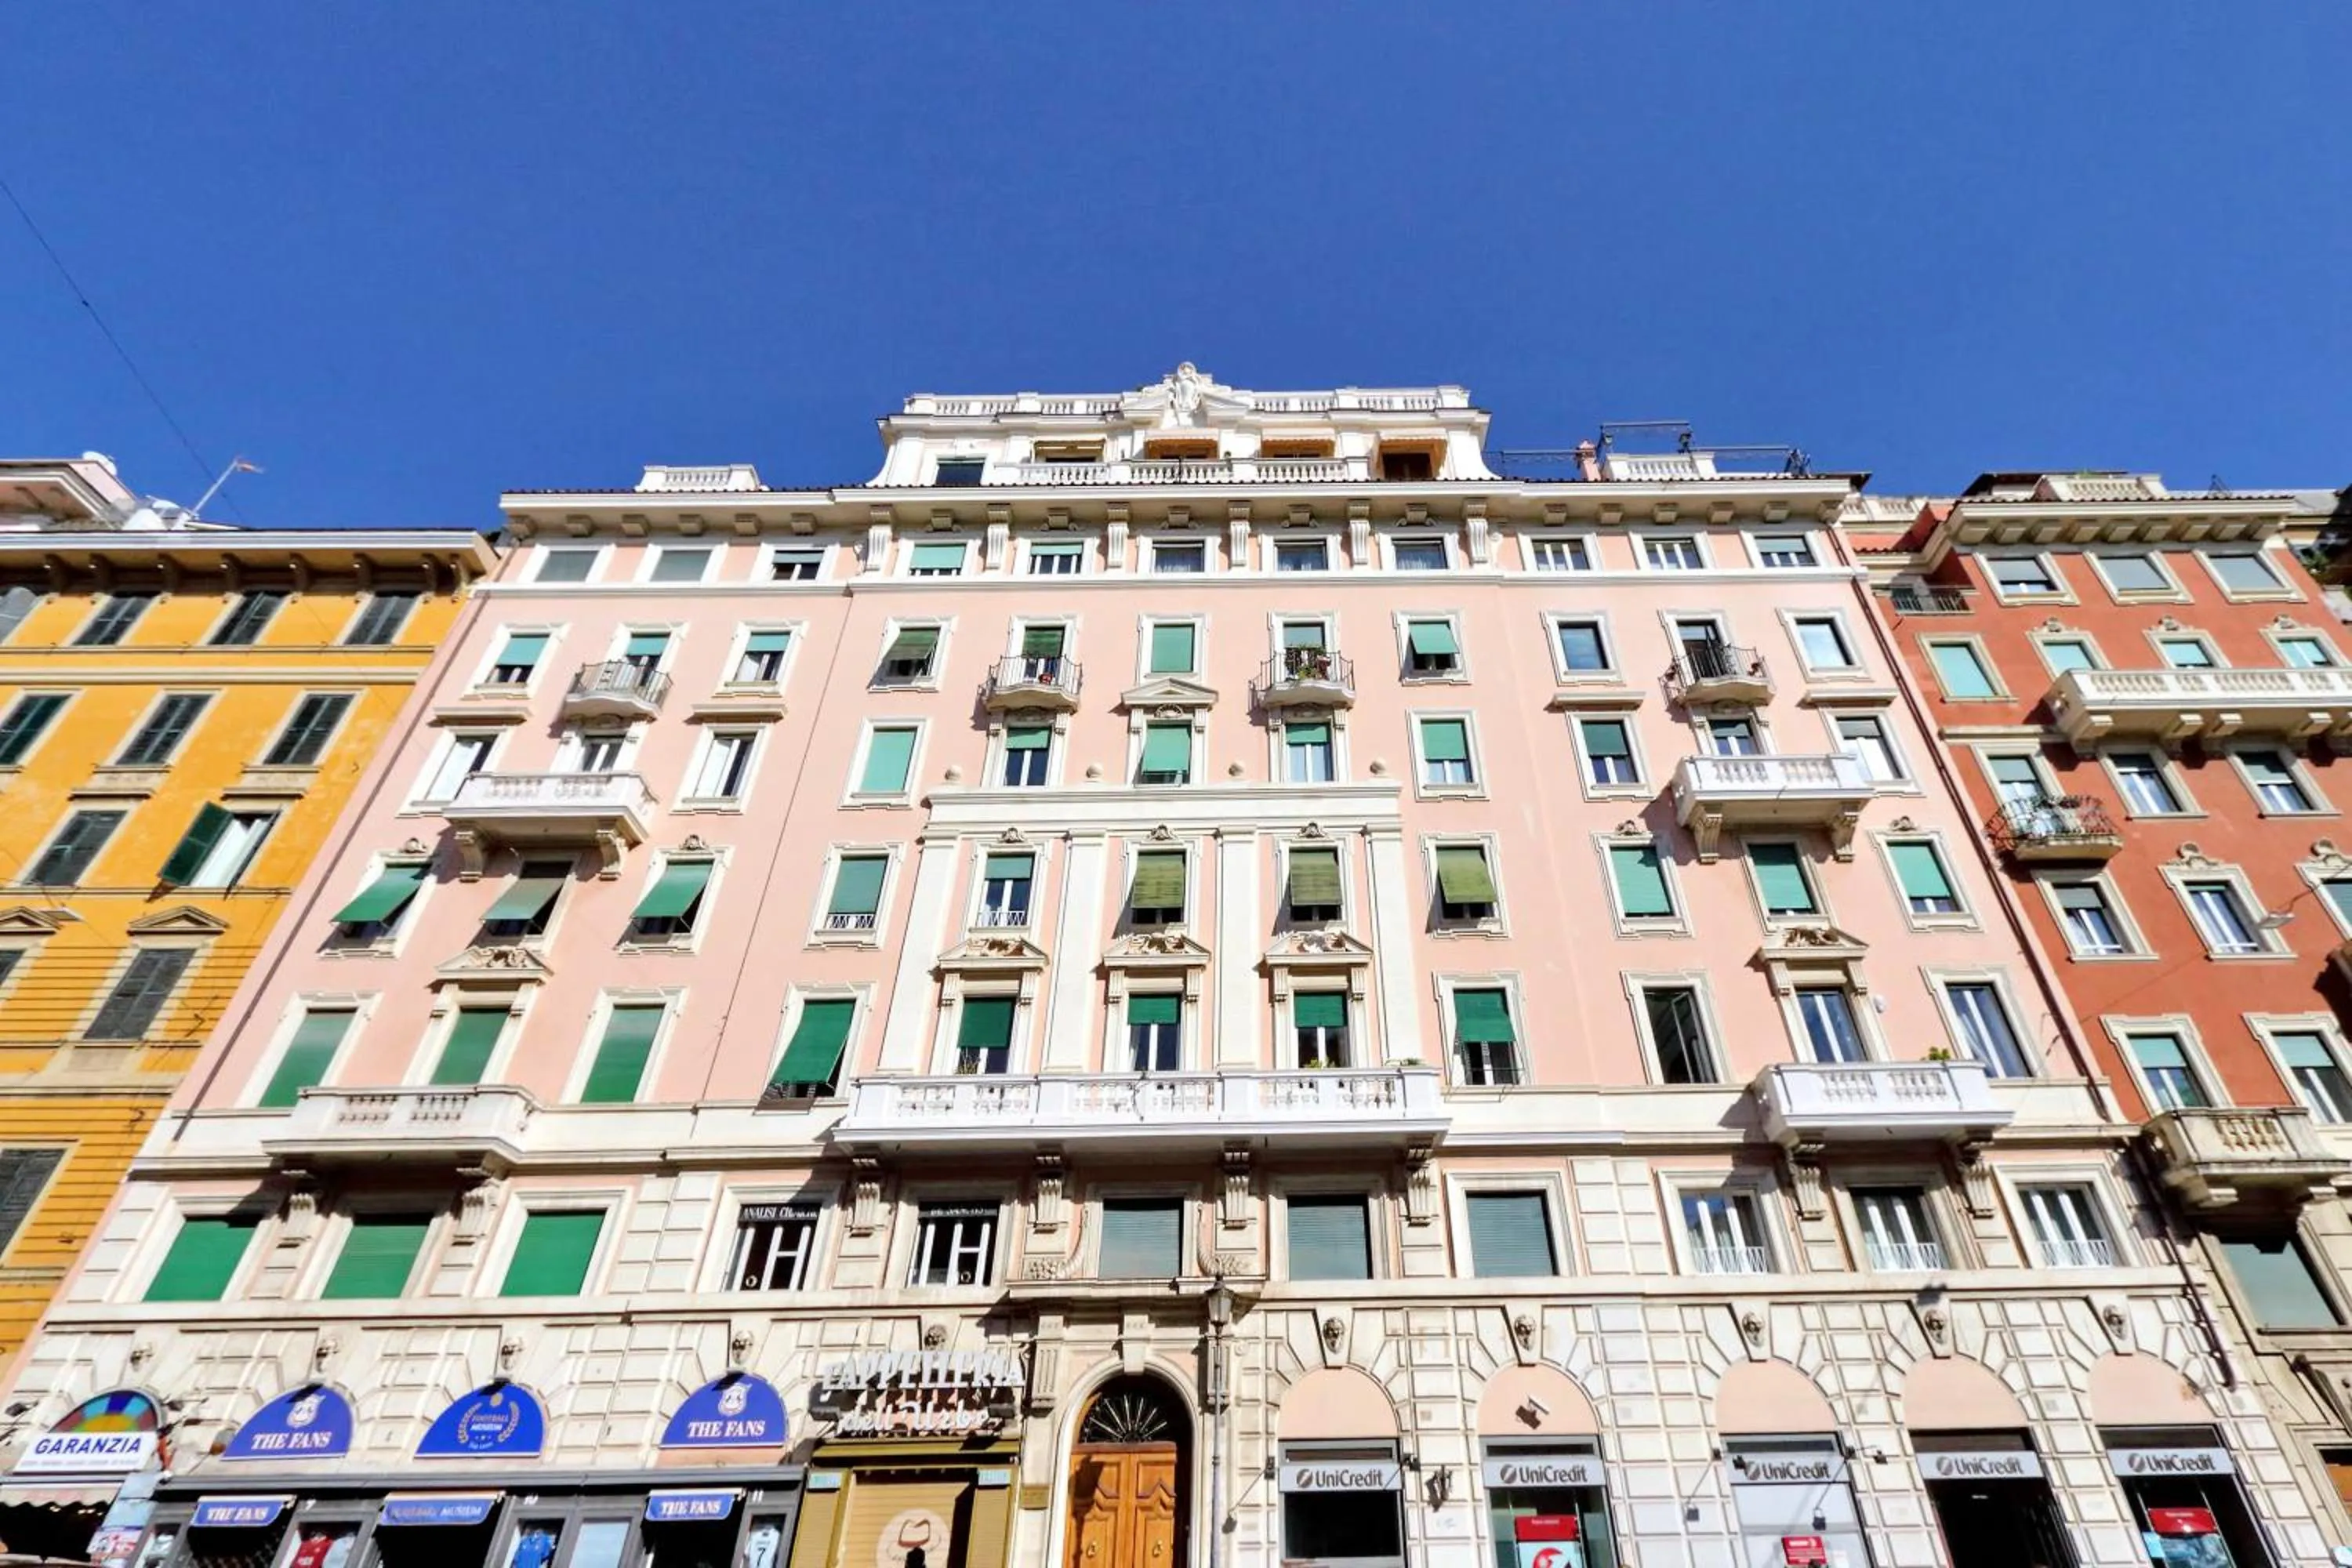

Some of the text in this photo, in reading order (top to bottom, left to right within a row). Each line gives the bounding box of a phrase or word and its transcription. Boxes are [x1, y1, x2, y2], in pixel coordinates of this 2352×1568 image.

[688, 1419, 766, 1438] THE FANS
[34, 1437, 143, 1455] GARANZIA
[251, 1431, 332, 1450] THE FANS
[1761, 1461, 1831, 1480] UniCredit
[1954, 1457, 2024, 1475] UniCredit
[2145, 1454, 2216, 1472] UniCredit
[1315, 1468, 1384, 1488] UniCredit
[1519, 1464, 1588, 1483] UniCredit
[206, 1507, 269, 1521] THE FANS
[661, 1500, 721, 1515] THE FANS
[757, 1547, 767, 1567] 7
